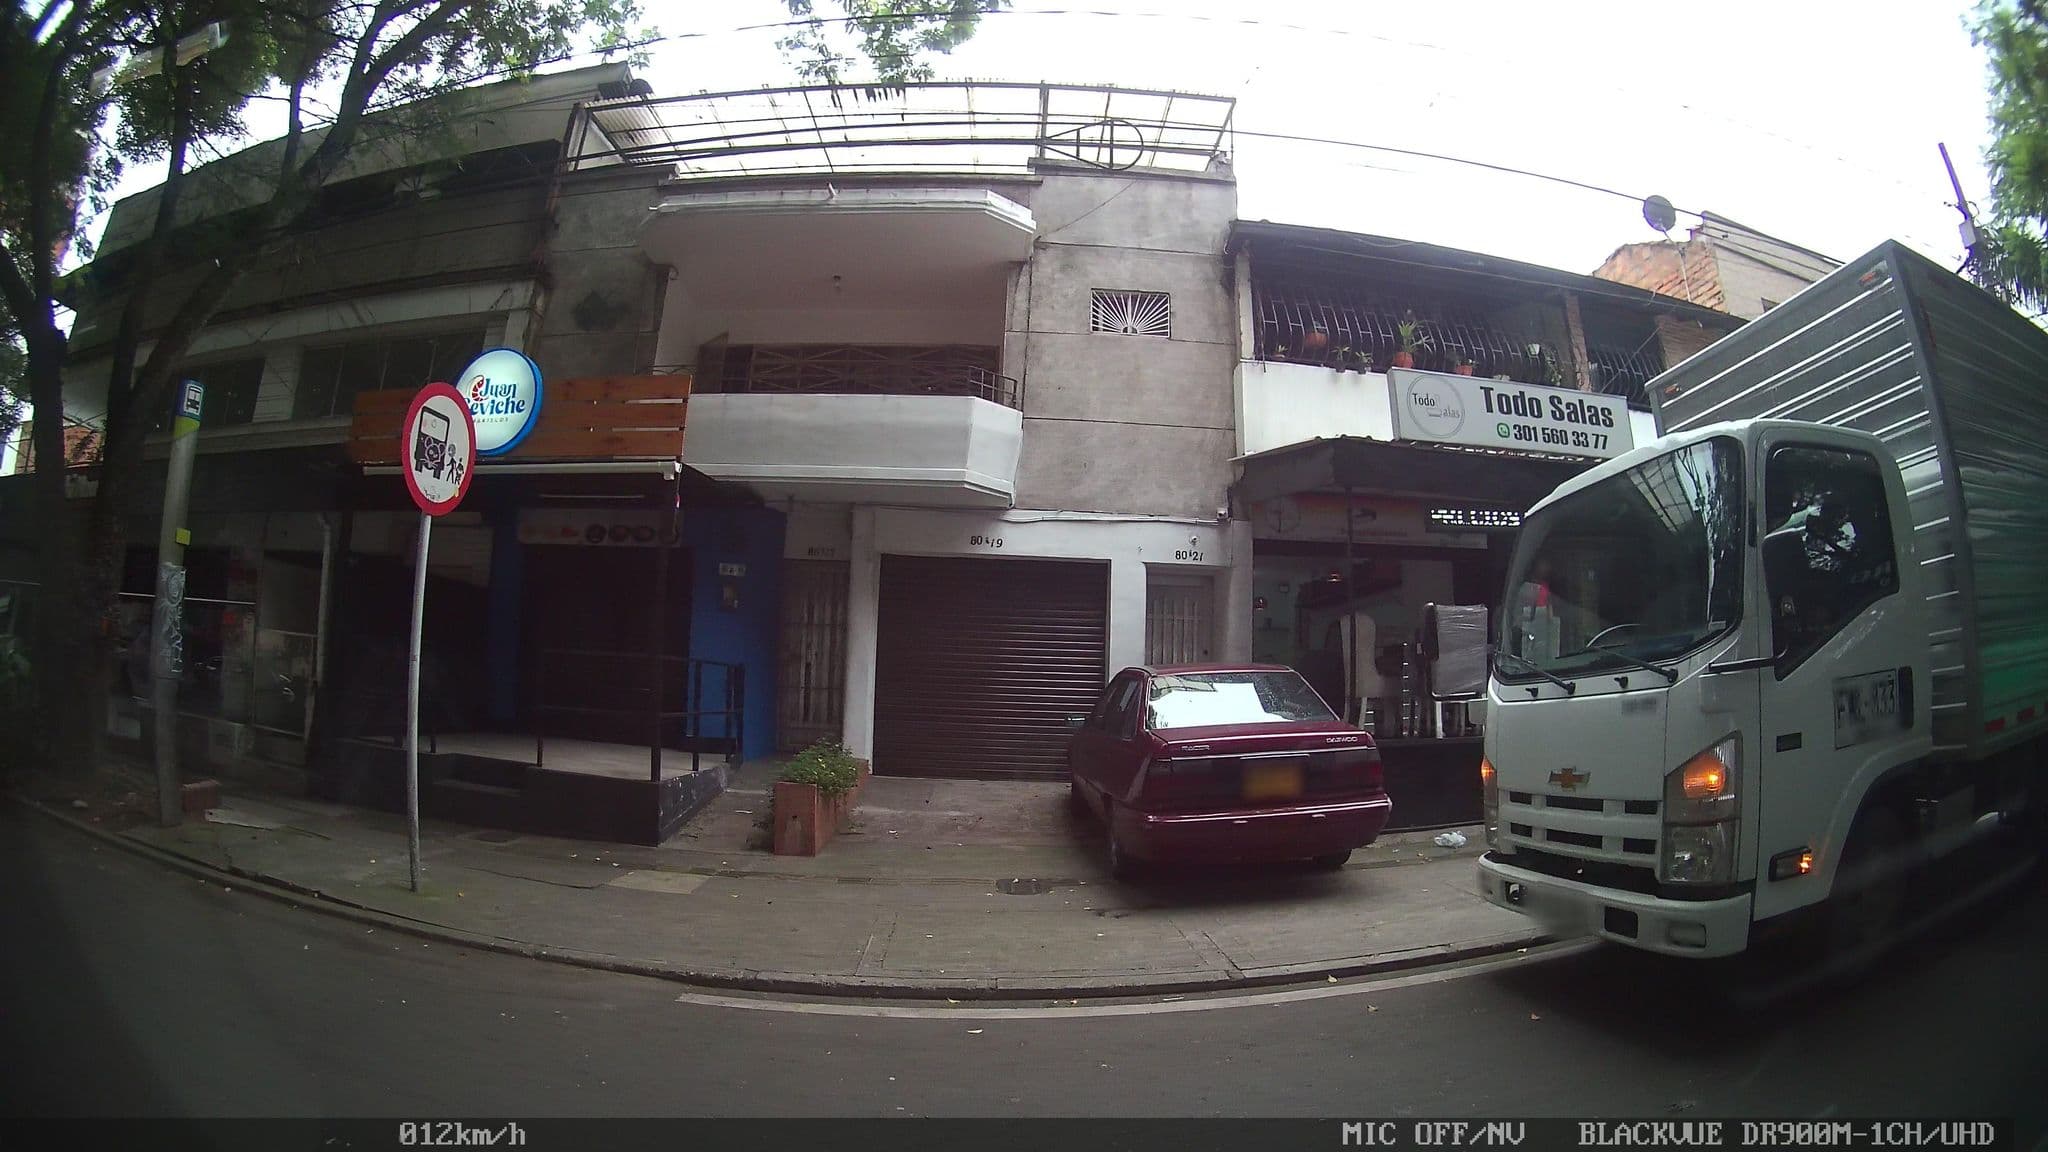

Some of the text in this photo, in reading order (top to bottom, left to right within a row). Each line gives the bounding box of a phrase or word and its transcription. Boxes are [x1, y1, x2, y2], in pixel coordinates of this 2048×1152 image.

[480, 378, 517, 398] Juan
[1412, 392, 1435, 407] Todo
[1480, 386, 1614, 428] Todo Salas
[1513, 424, 1608, 450] 301 560 33 77
